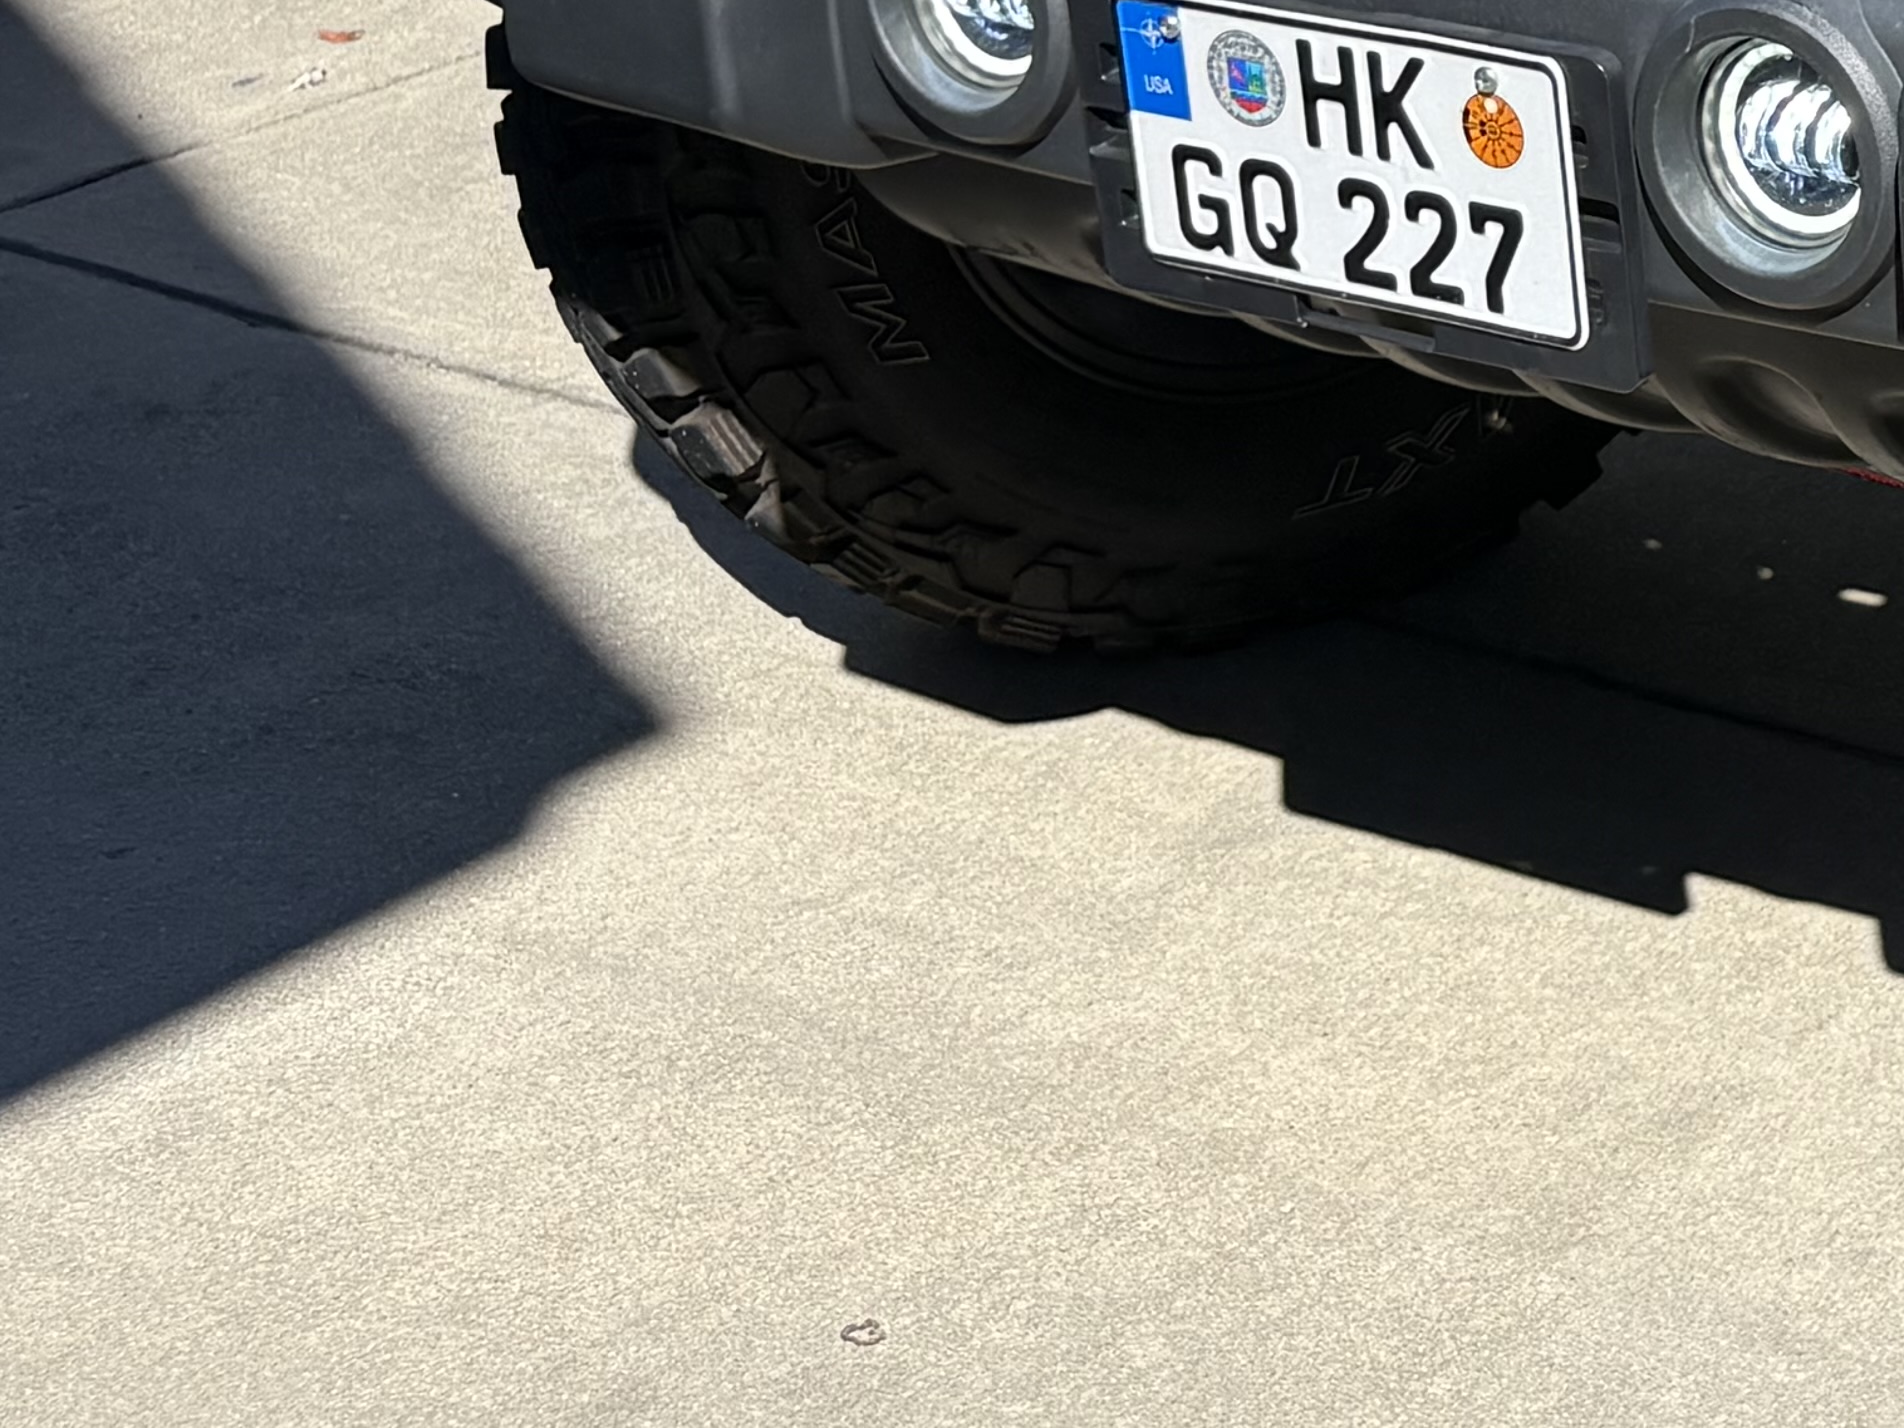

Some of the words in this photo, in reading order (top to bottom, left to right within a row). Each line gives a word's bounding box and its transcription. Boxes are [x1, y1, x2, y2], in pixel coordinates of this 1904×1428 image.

[1143, 75, 1173, 96] USA
[1296, 38, 1435, 170] HK
[1171, 143, 1302, 273] GQ
[1337, 177, 1524, 314] 227
